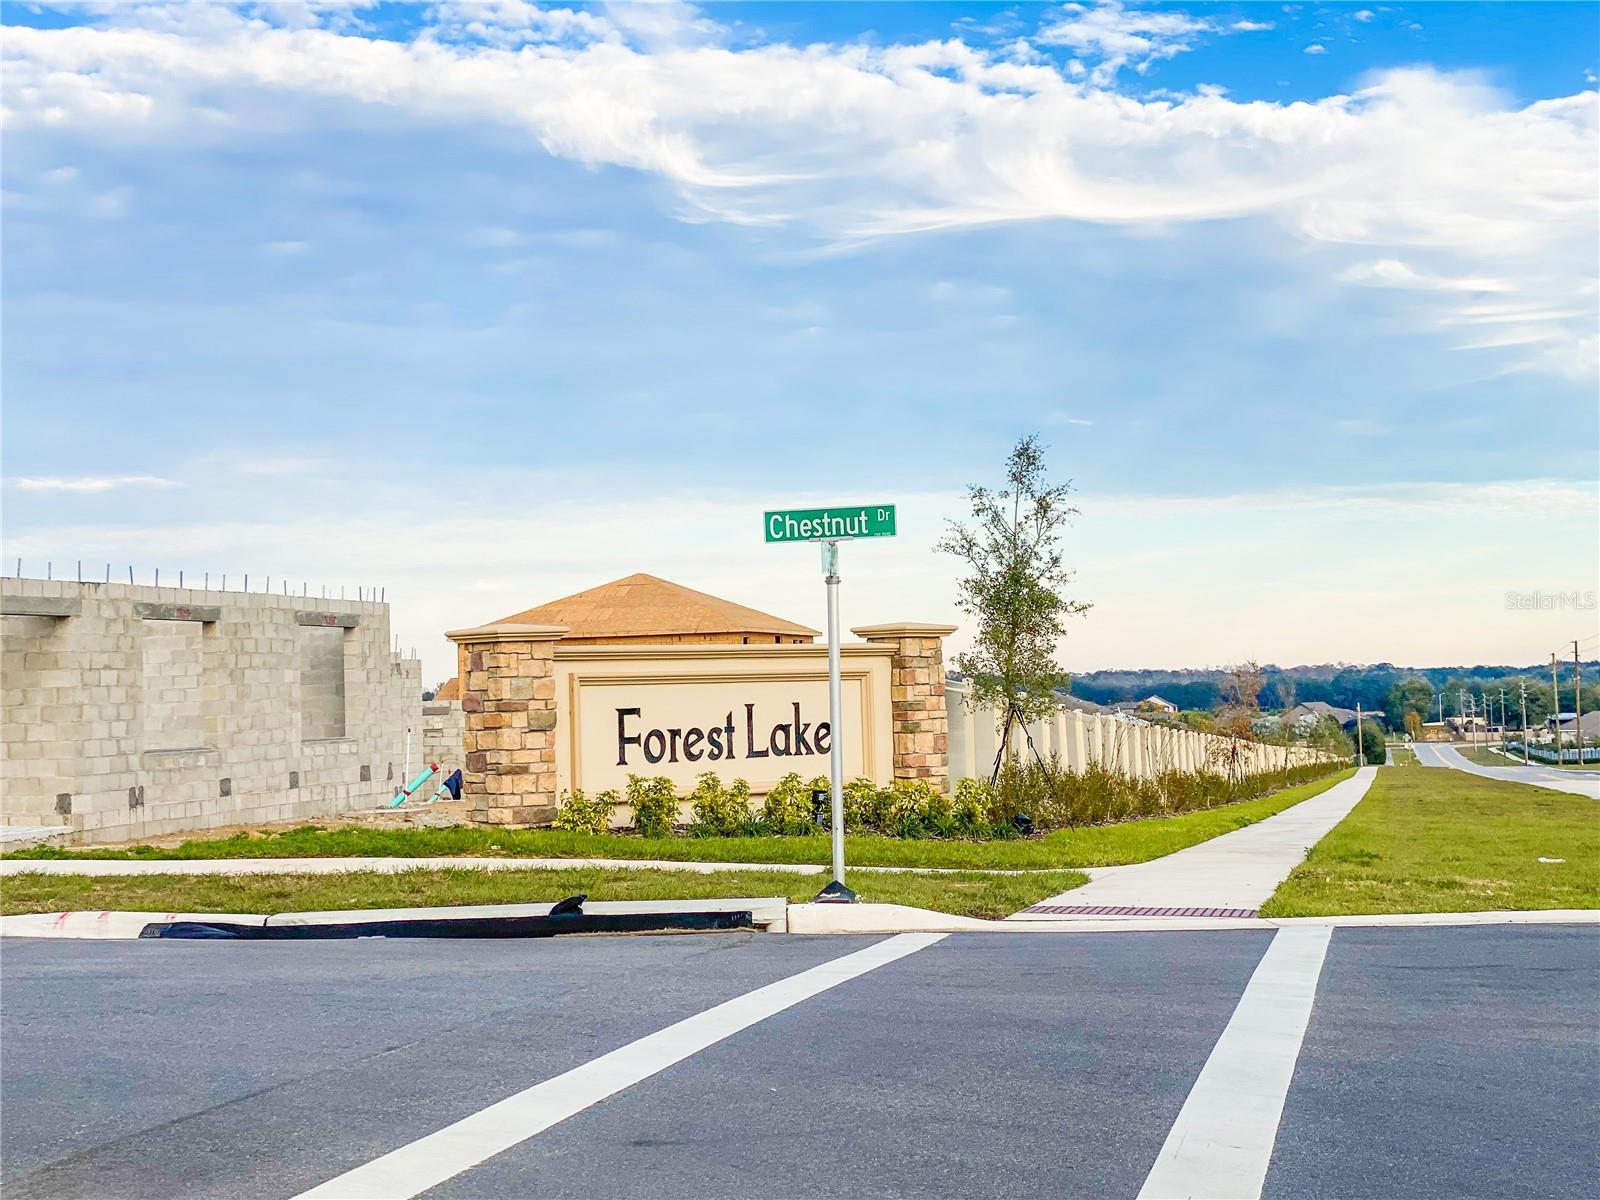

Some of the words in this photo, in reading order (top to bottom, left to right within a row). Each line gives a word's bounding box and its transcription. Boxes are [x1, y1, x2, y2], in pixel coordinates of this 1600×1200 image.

[769, 511, 868, 538] Chestnut
[877, 509, 890, 521] Dr
[615, 707, 736, 766] Forest
[744, 702, 832, 758] Lake
